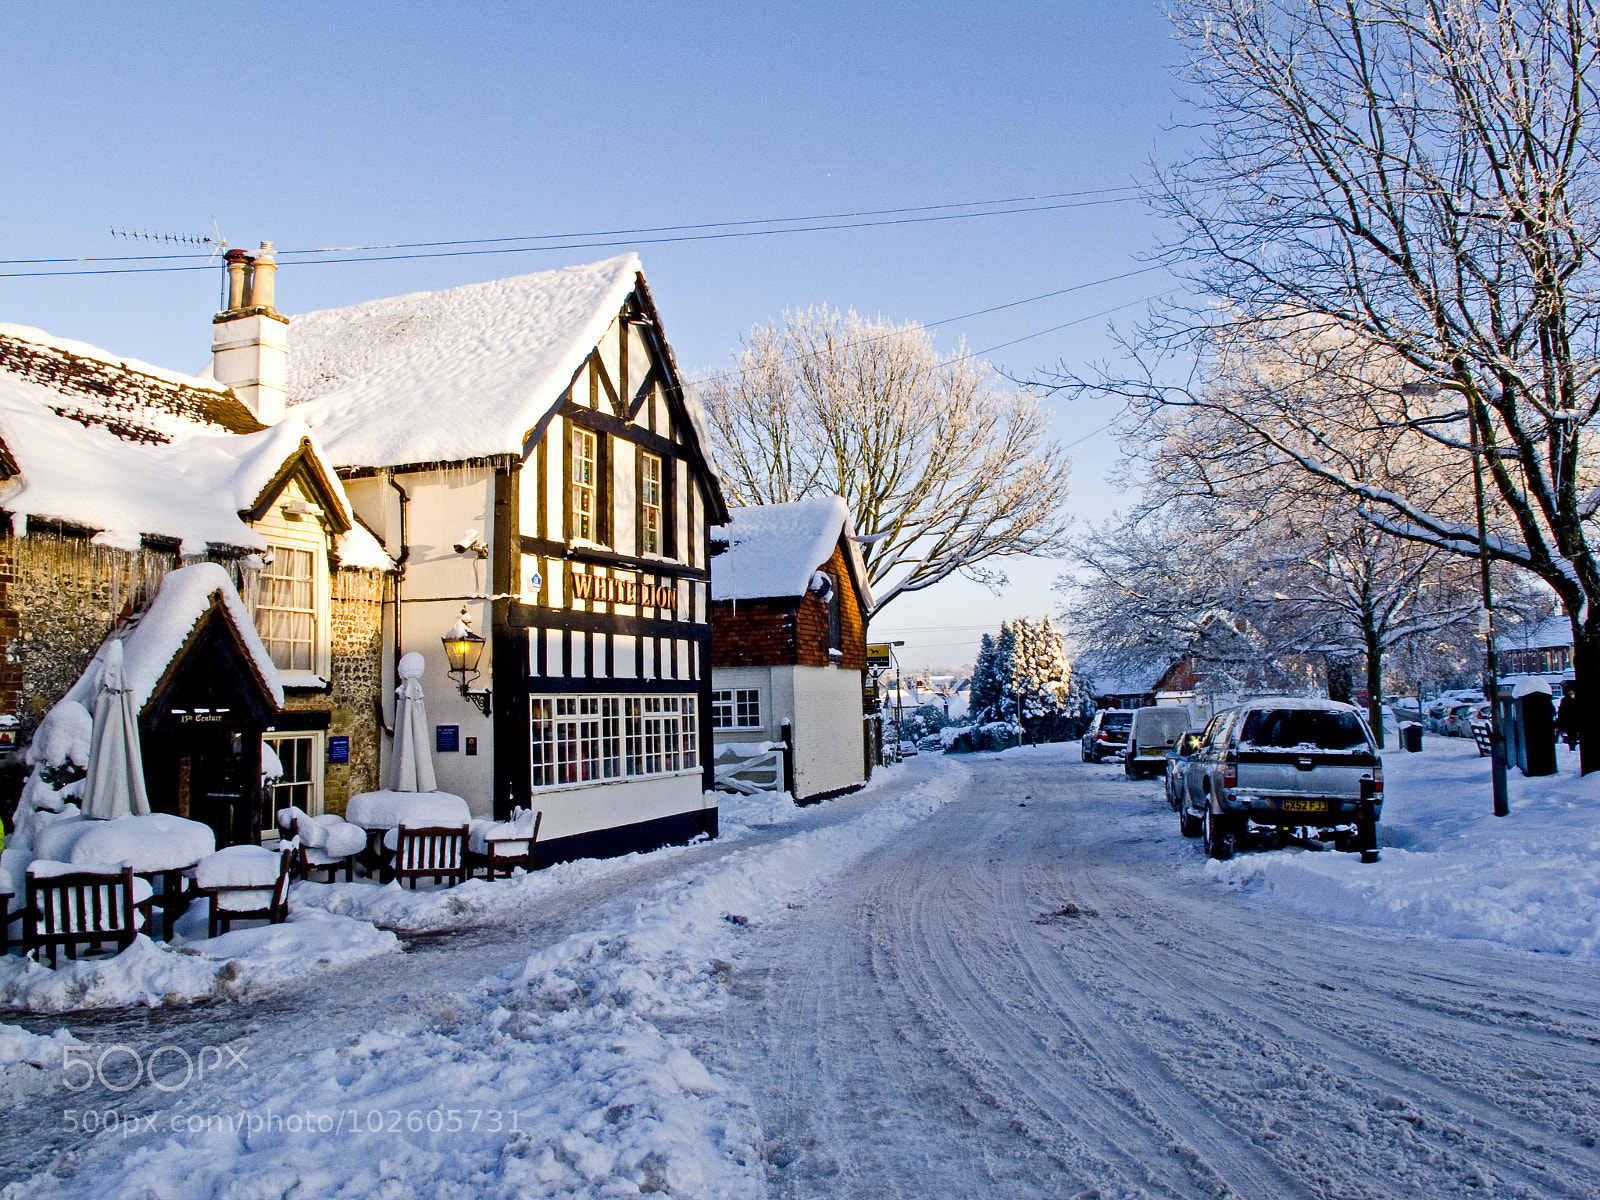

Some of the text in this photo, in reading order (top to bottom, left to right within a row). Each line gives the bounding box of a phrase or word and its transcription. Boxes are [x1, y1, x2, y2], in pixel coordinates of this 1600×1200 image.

[572, 572, 677, 611] WHITE LION
[1284, 801, 1308, 811] GX52
